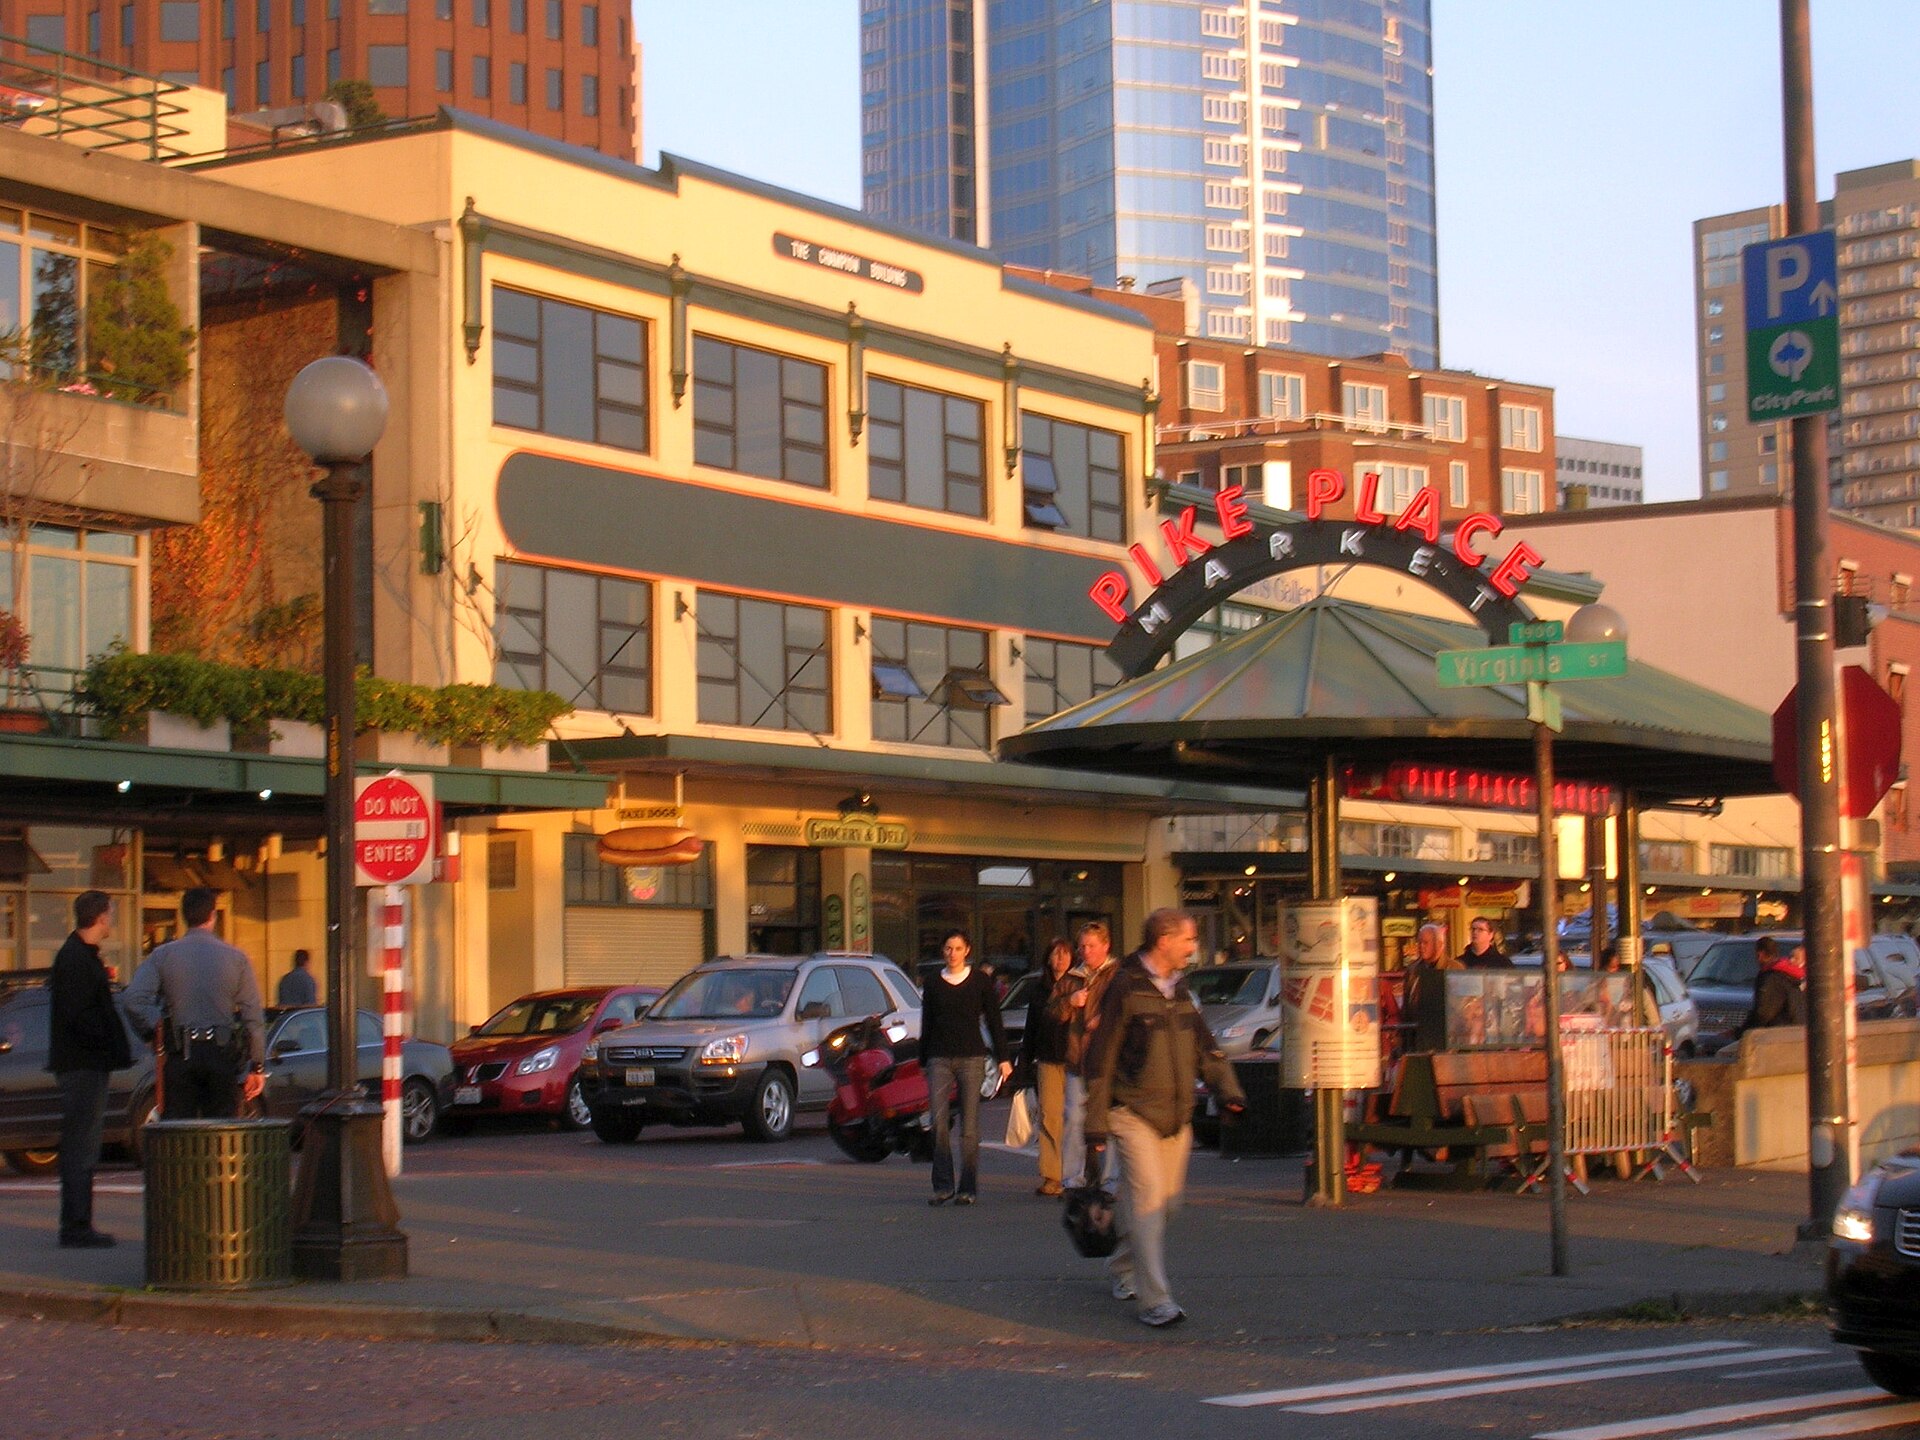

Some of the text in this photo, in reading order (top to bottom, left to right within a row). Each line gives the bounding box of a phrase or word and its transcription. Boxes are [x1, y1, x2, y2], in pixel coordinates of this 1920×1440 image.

[790, 239, 811, 260] THE
[1765, 244, 1811, 319] P
[1751, 385, 1835, 411] CityPark
[1087, 467, 1544, 625] PIKE PLACE
[1138, 528, 1499, 637] MARKET
[1453, 652, 1562, 682] Virginia
[1408, 767, 1611, 814] PIKE PLACE ARKET
[364, 796, 420, 816] DO NOT
[364, 843, 416, 863] ENTER
